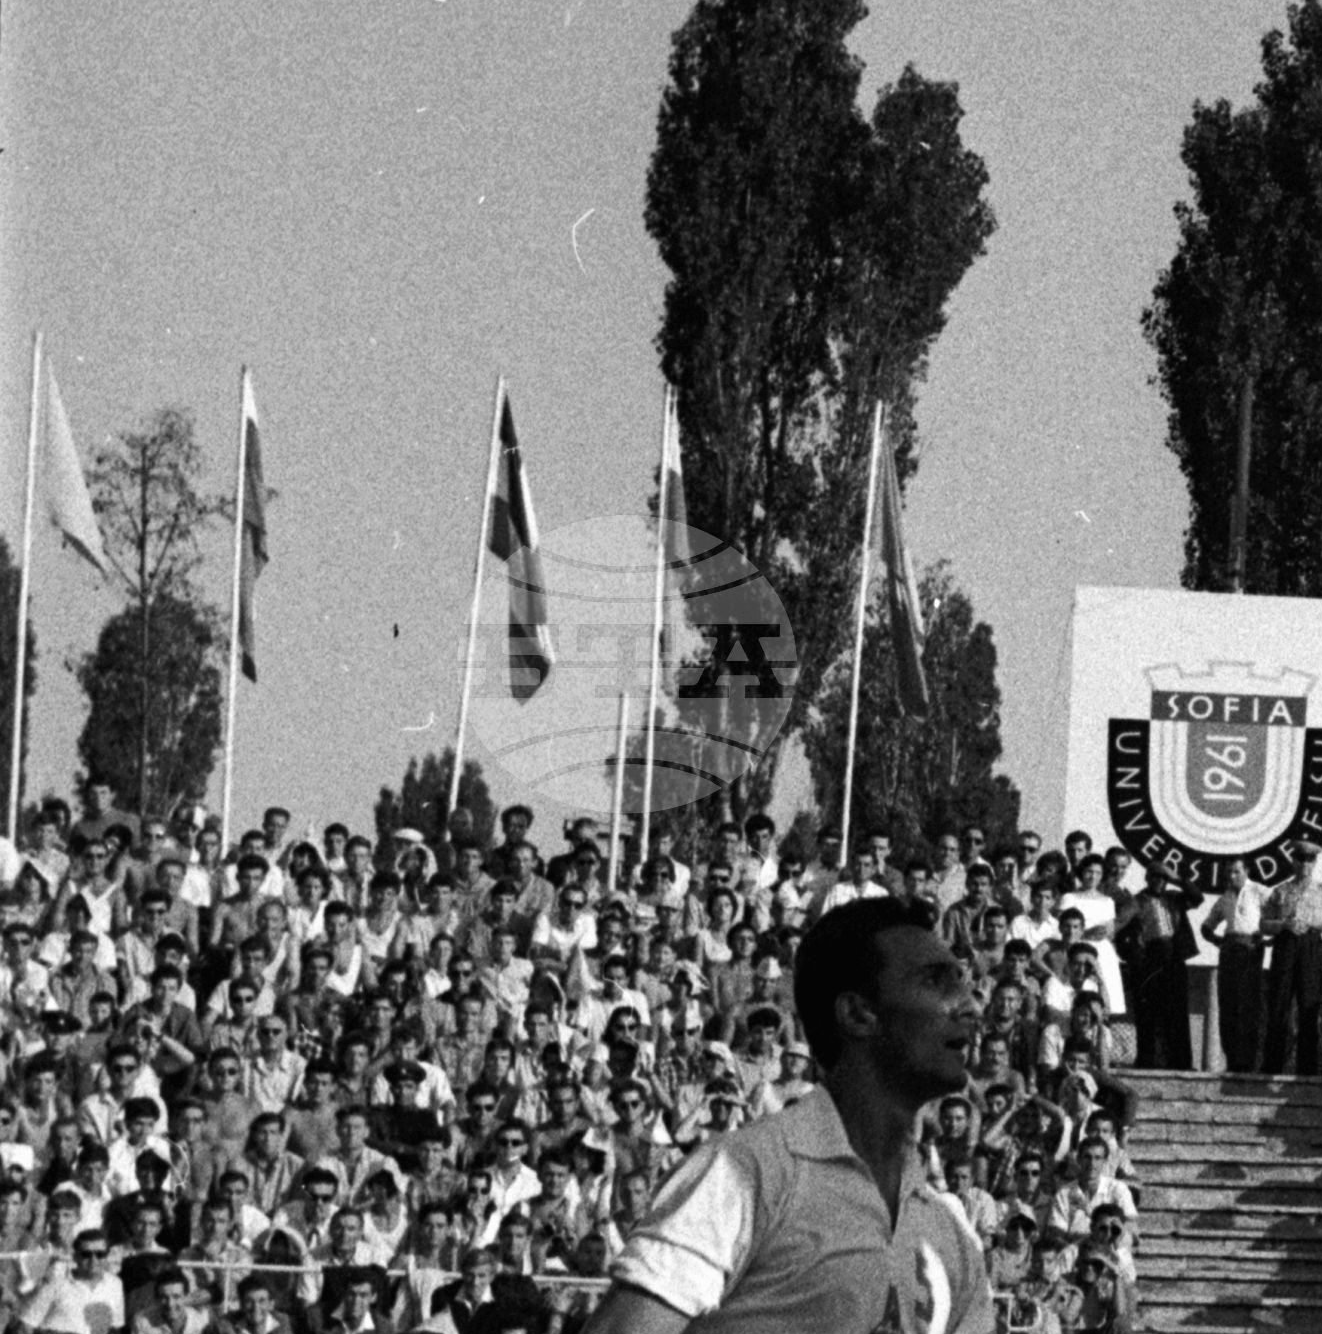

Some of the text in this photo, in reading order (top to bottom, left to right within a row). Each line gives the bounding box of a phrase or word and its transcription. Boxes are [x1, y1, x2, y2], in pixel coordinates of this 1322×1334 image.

[1167, 694, 1293, 725] SOFIA
[1203, 734, 1248, 801] 1961
[1115, 731, 1299, 887] UNIVERSIDE
